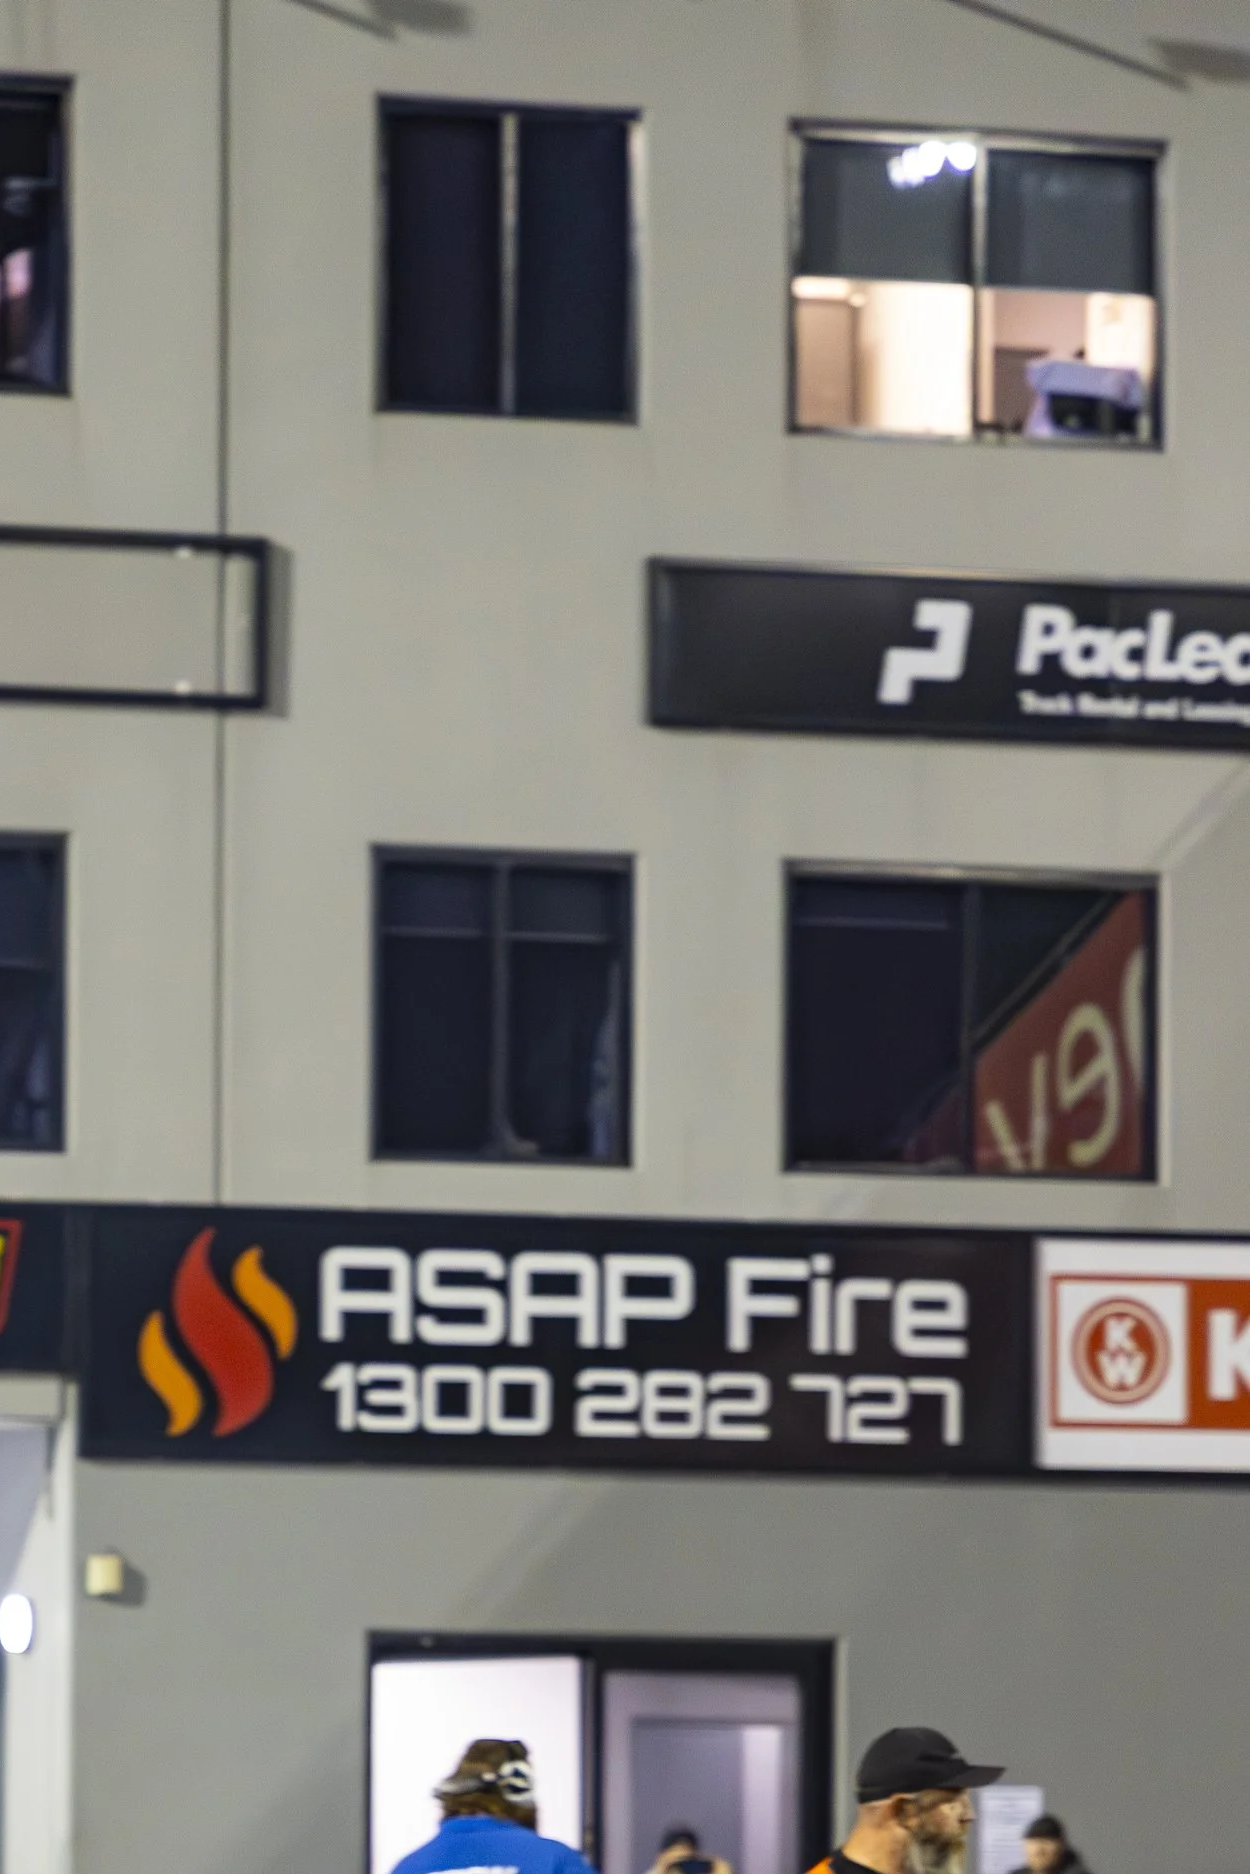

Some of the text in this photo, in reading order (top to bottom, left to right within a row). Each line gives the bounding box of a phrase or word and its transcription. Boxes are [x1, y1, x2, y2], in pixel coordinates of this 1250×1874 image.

[319, 1246, 969, 1358] ASAP Fire
[319, 1361, 962, 1446] 1300 282 727
